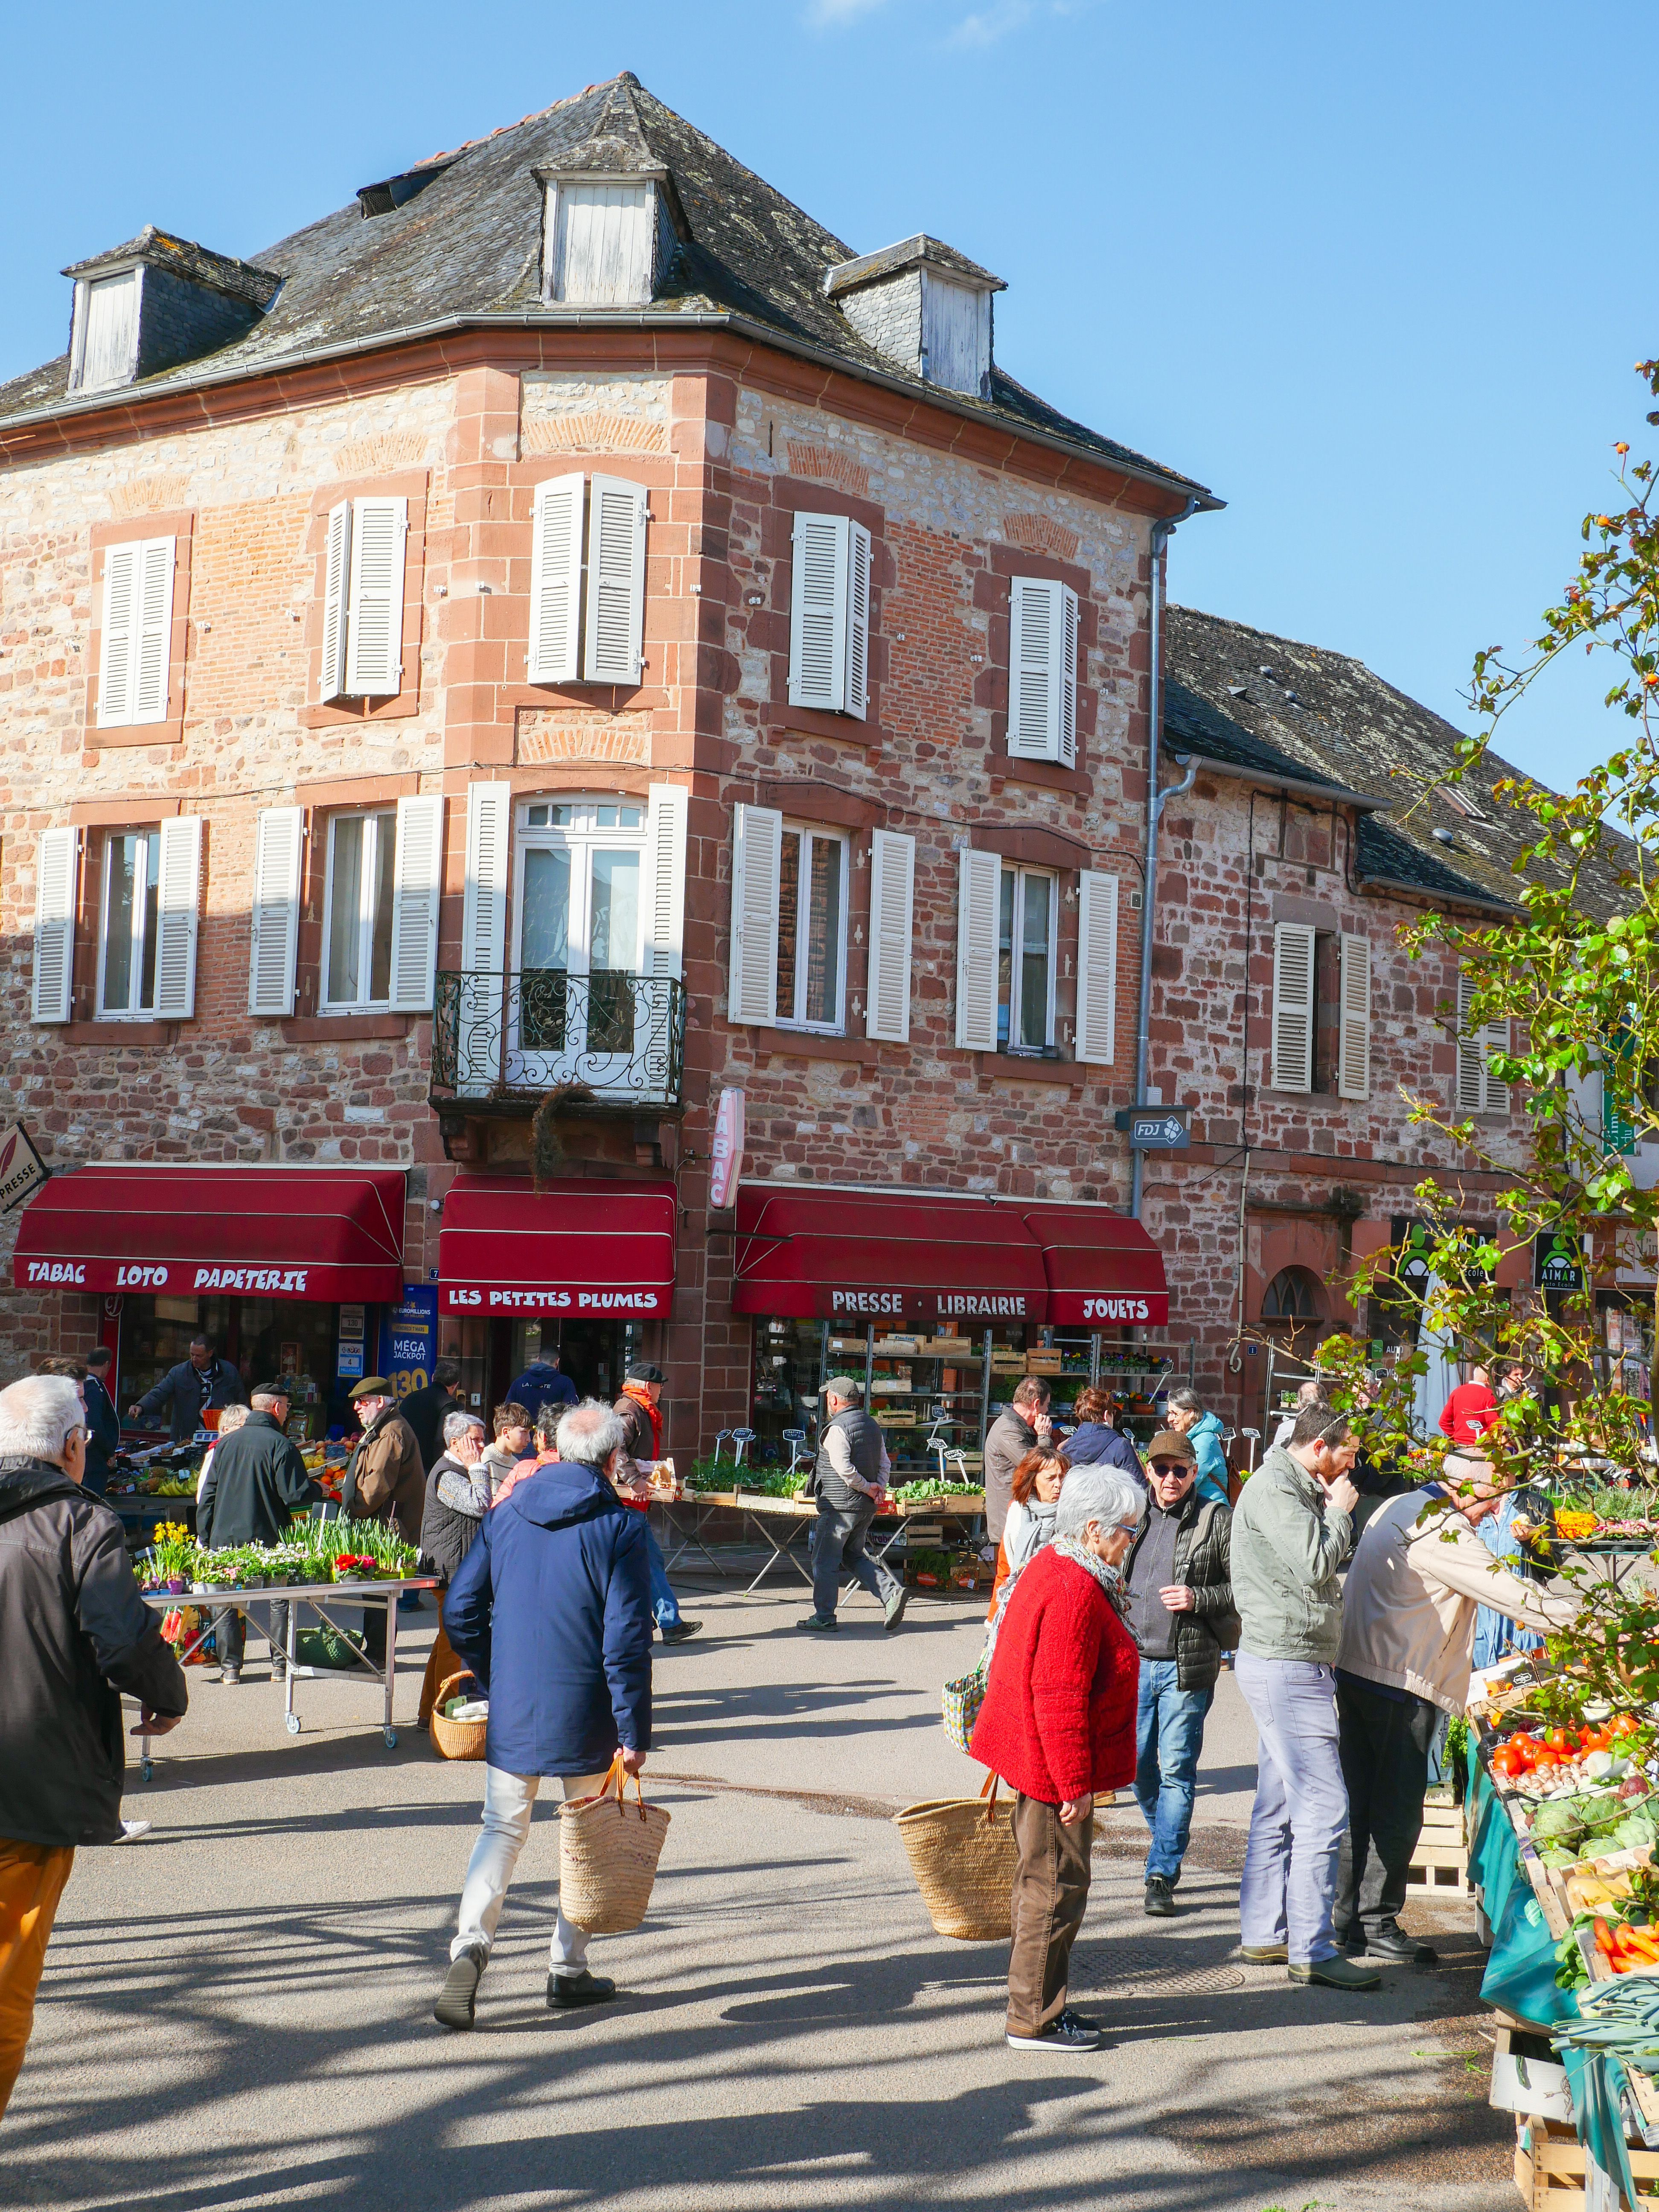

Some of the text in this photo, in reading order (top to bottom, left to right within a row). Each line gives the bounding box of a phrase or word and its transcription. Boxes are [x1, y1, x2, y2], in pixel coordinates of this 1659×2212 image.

[1138, 1124, 1160, 1135] FDJ
[711, 1090, 731, 1204] TABAC
[0, 1163, 35, 1199] PRESSE
[28, 1262, 308, 1292] TABAC LOTO PAPETERIE
[1541, 1269, 1575, 1281] AIMAR
[449, 1290, 658, 1308] LES PETITES PLUMES
[832, 1291, 1026, 1316] PRESSE LIBRAIRIE
[1083, 1298, 1149, 1319] JOUETS
[393, 1351, 426, 1360] JACKPOT
[394, 1340, 426, 1353] MÉGA
[387, 1368, 428, 1400] 130
